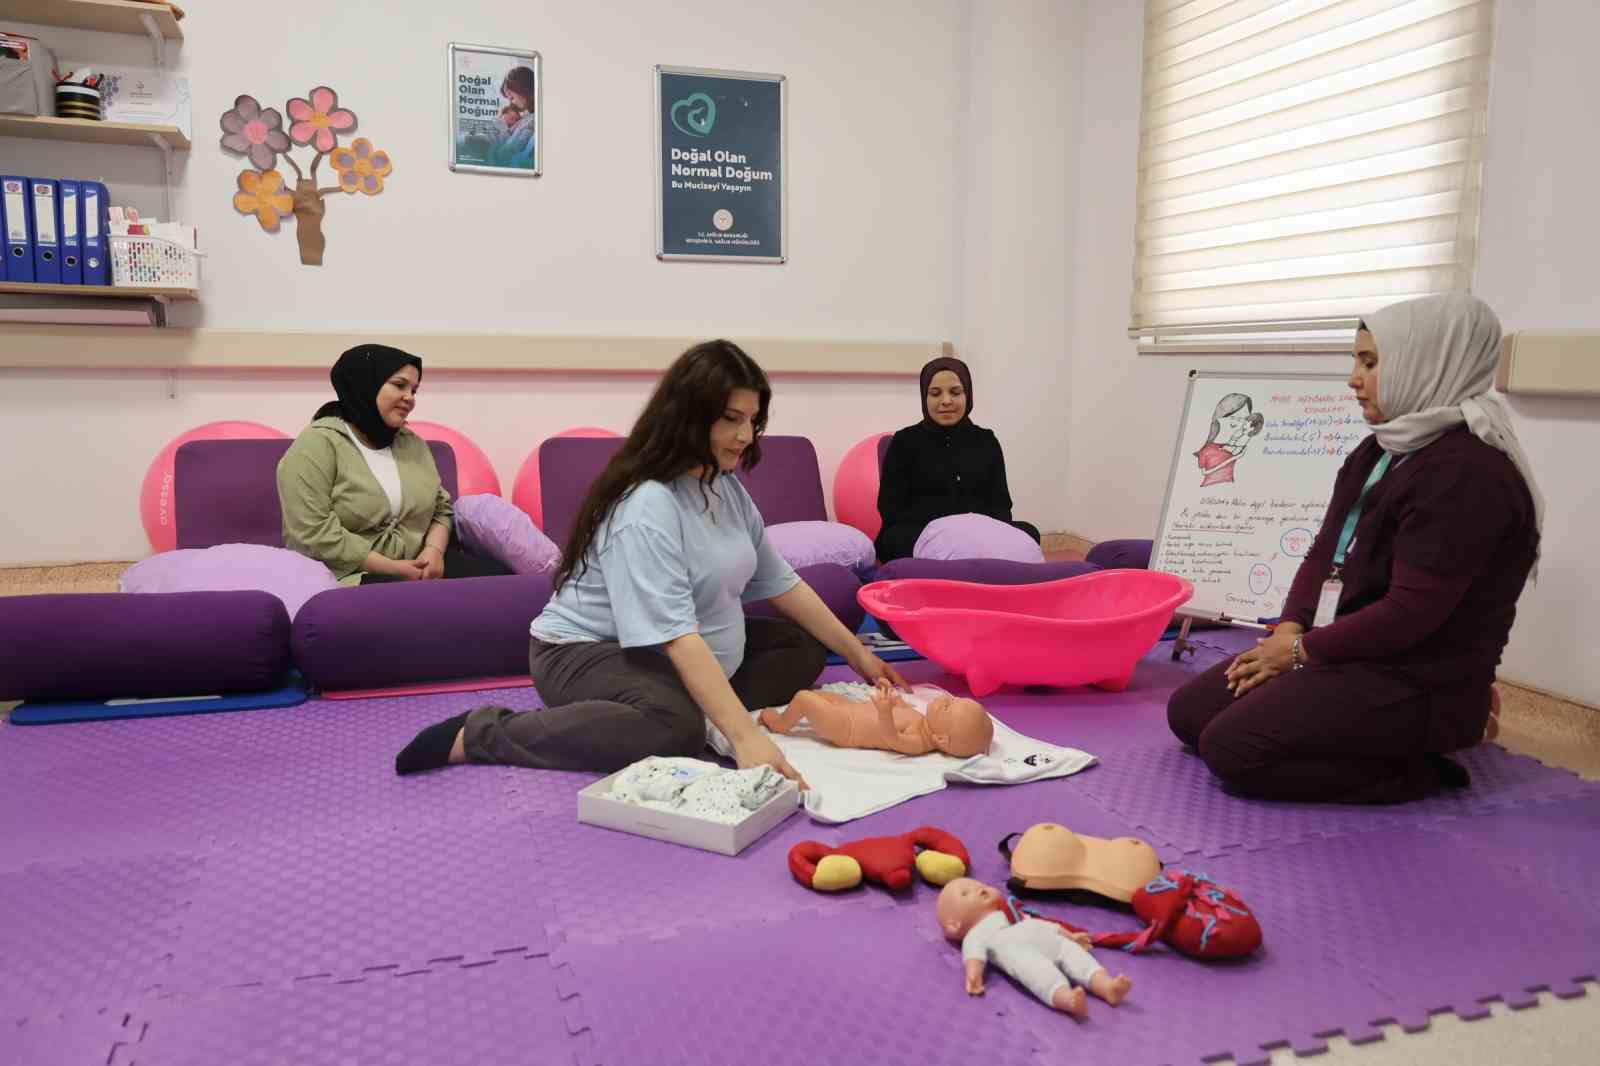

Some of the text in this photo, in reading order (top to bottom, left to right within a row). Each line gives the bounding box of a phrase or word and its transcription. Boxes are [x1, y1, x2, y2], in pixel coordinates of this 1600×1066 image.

[459, 74, 492, 86] Doğal
[459, 85, 486, 95] Olan
[459, 95, 500, 107] Normal
[459, 105, 498, 117] Doğum
[671, 148, 746, 164] Doğal Olan
[671, 163, 772, 182] Normal Doğum
[672, 181, 752, 193] Bu Mucizeyi Yaşayın
